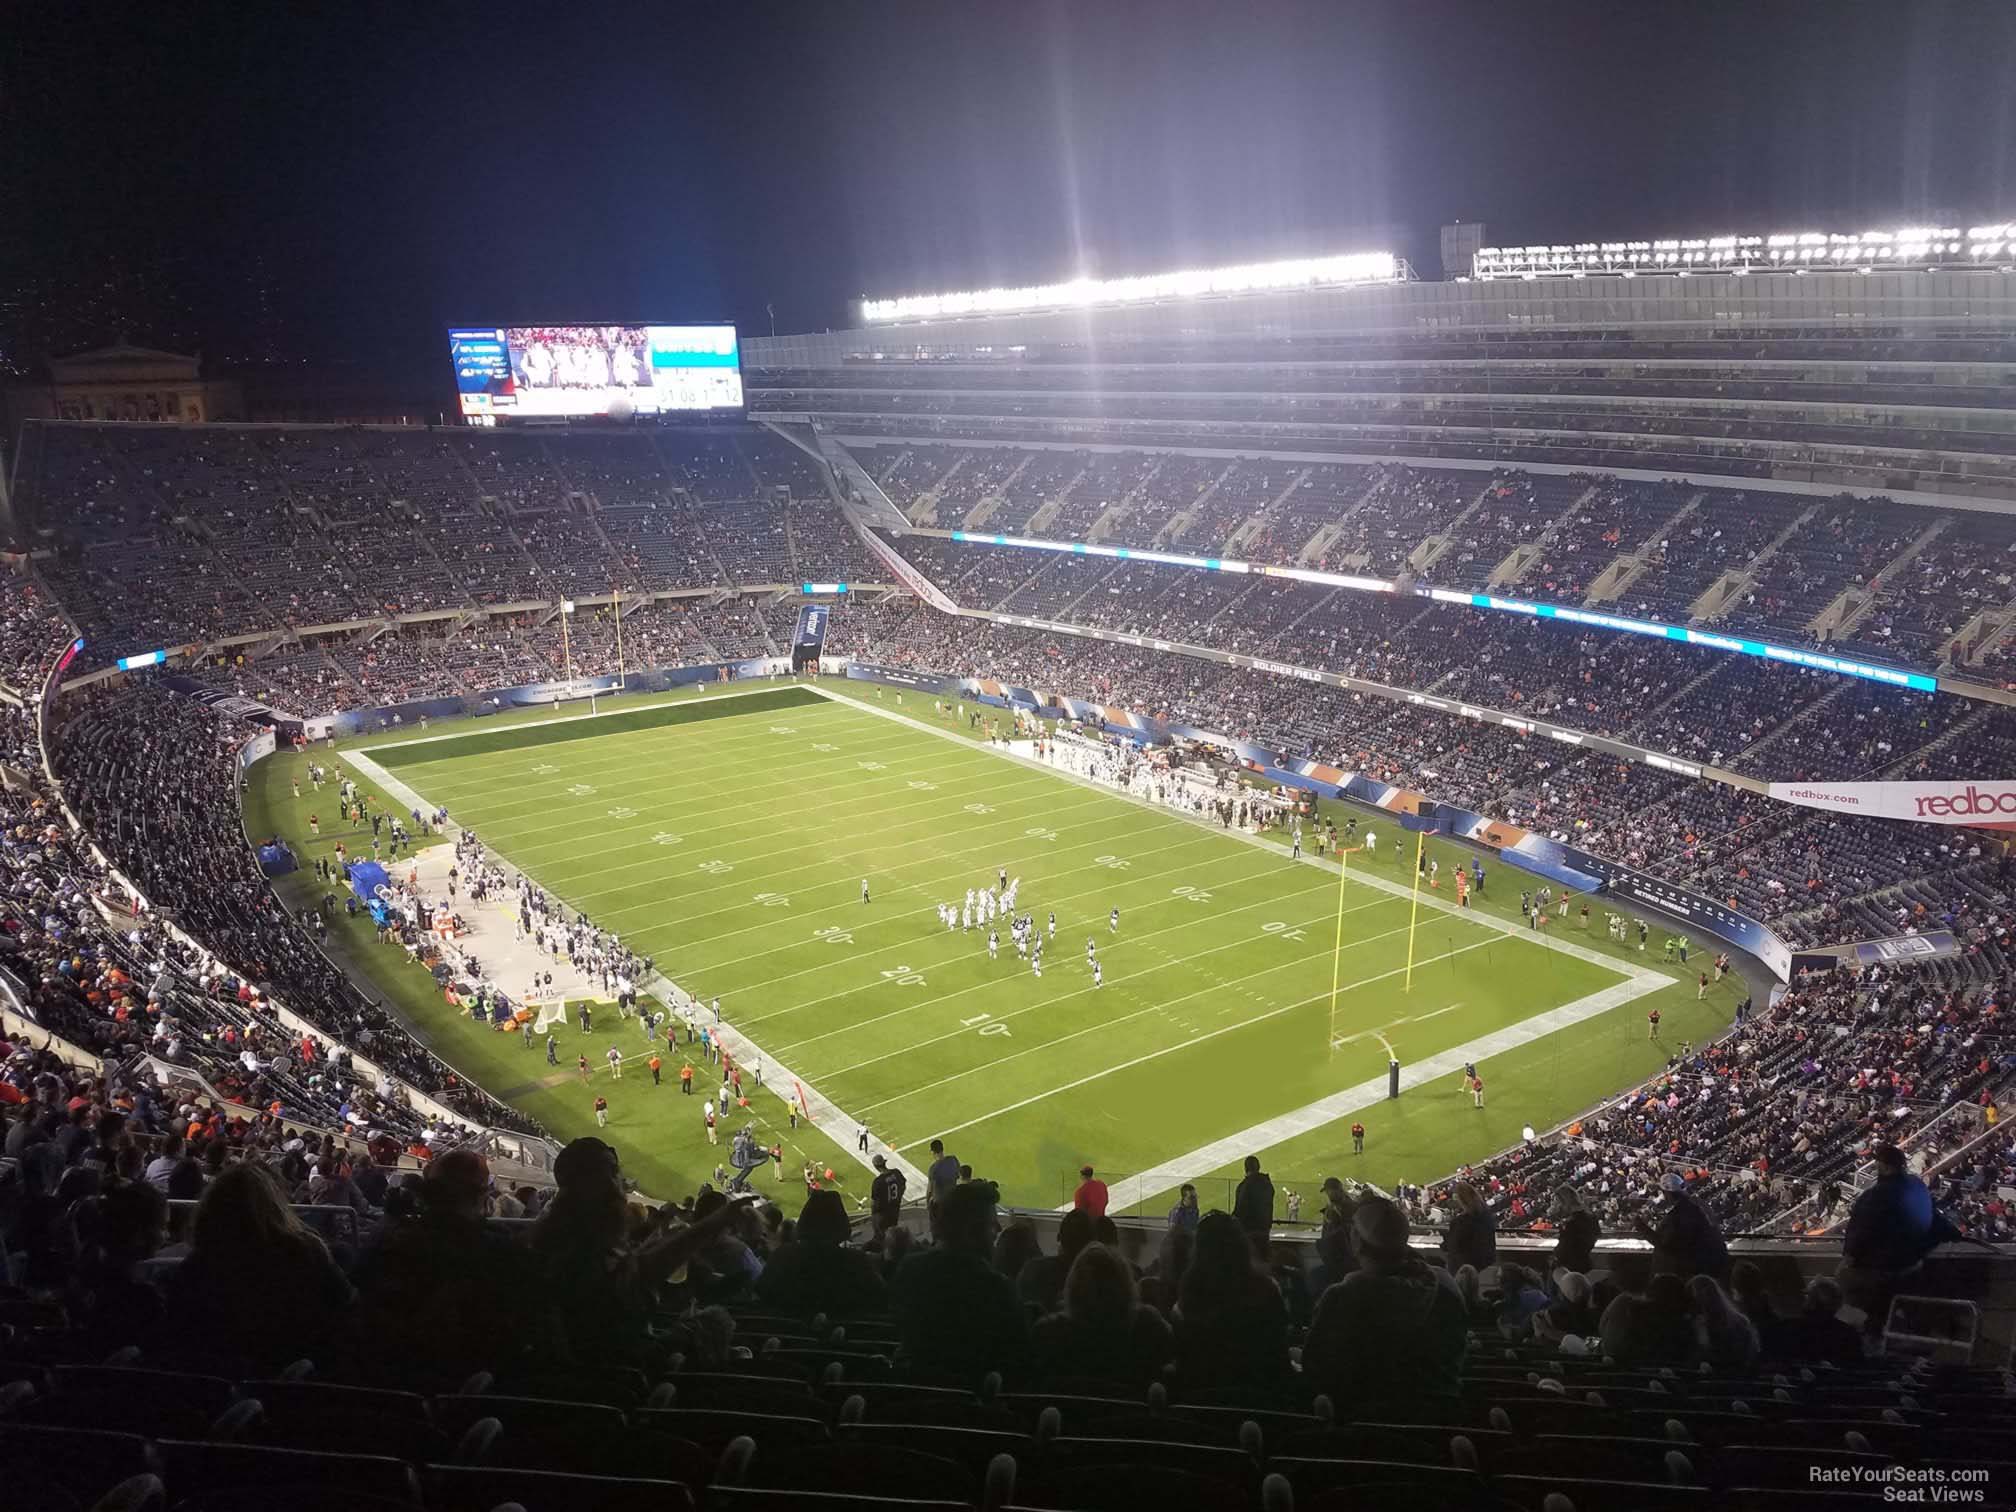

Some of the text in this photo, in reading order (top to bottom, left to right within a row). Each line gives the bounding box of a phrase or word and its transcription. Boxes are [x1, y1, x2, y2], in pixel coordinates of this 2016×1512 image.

[1252, 660, 1322, 682] SOLDIER FIELD
[1789, 788, 1859, 805] redbox.com
[814, 926, 851, 944] 30
[880, 965, 923, 986] 20
[960, 1013, 1008, 1036] 10
